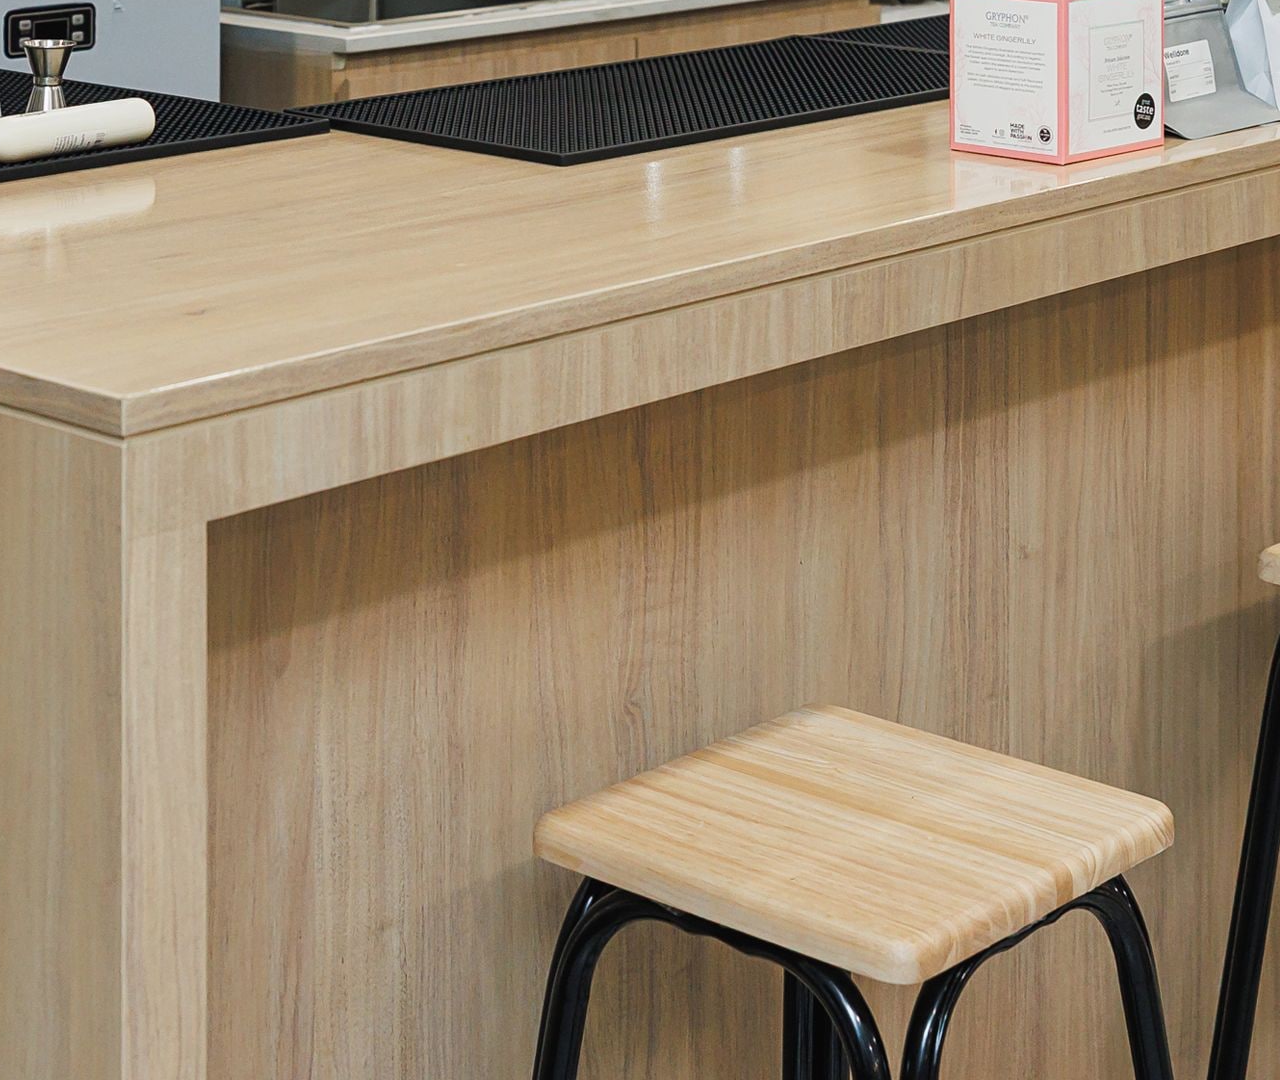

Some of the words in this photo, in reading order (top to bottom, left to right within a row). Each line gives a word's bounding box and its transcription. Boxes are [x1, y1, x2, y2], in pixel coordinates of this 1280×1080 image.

[973, 32, 996, 41] WHITE
[996, 35, 1037, 45] GINGERLILY
[1164, 48, 1190, 60] Welldone
[1136, 103, 1154, 115] taste
